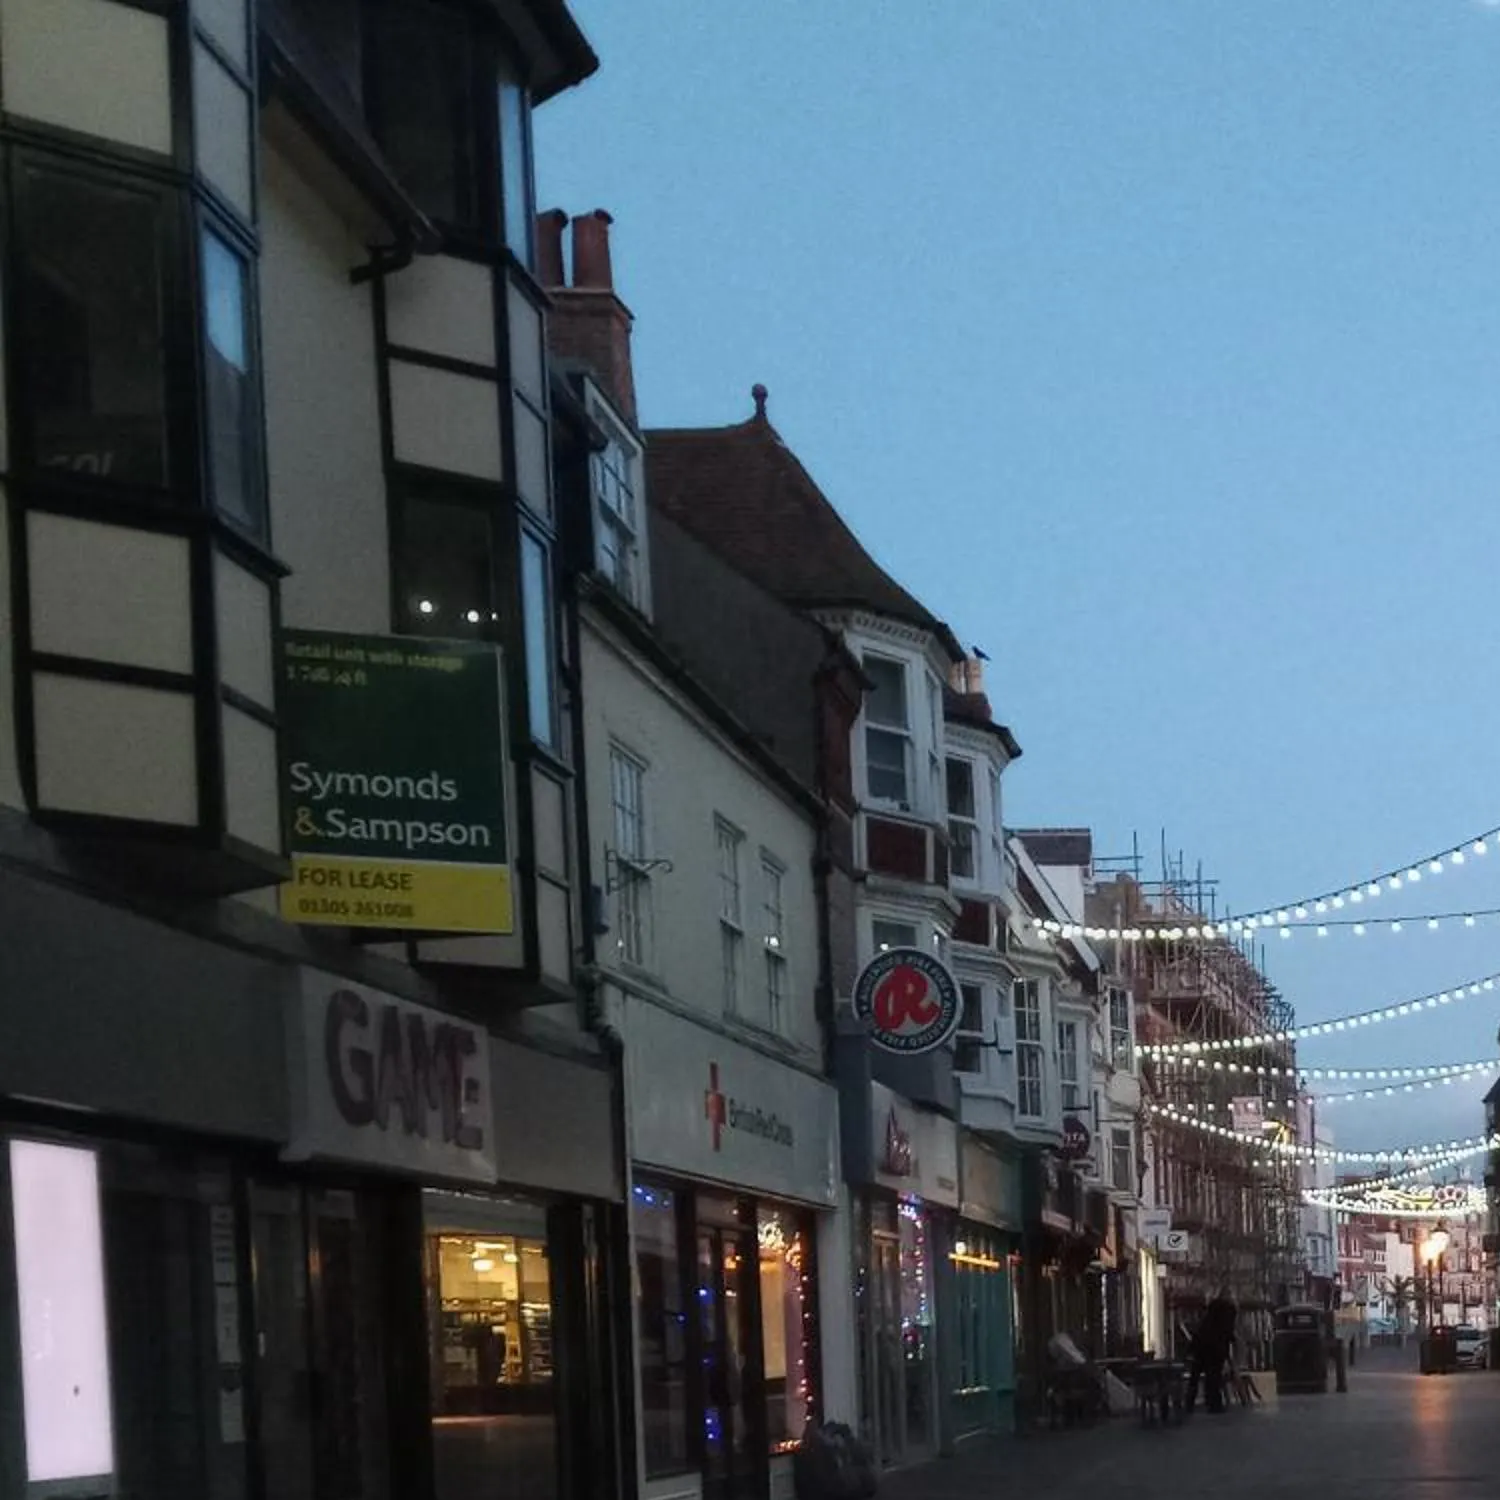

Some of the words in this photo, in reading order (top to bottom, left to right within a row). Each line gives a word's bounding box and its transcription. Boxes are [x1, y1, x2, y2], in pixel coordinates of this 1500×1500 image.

[368, 648, 404, 665] with
[289, 761, 459, 801] Symonds
[294, 806, 318, 837] &
[324, 807, 492, 850] Sampson
[298, 866, 342, 888] FOR
[349, 869, 414, 892] LEASE
[325, 989, 484, 1150] GAME
